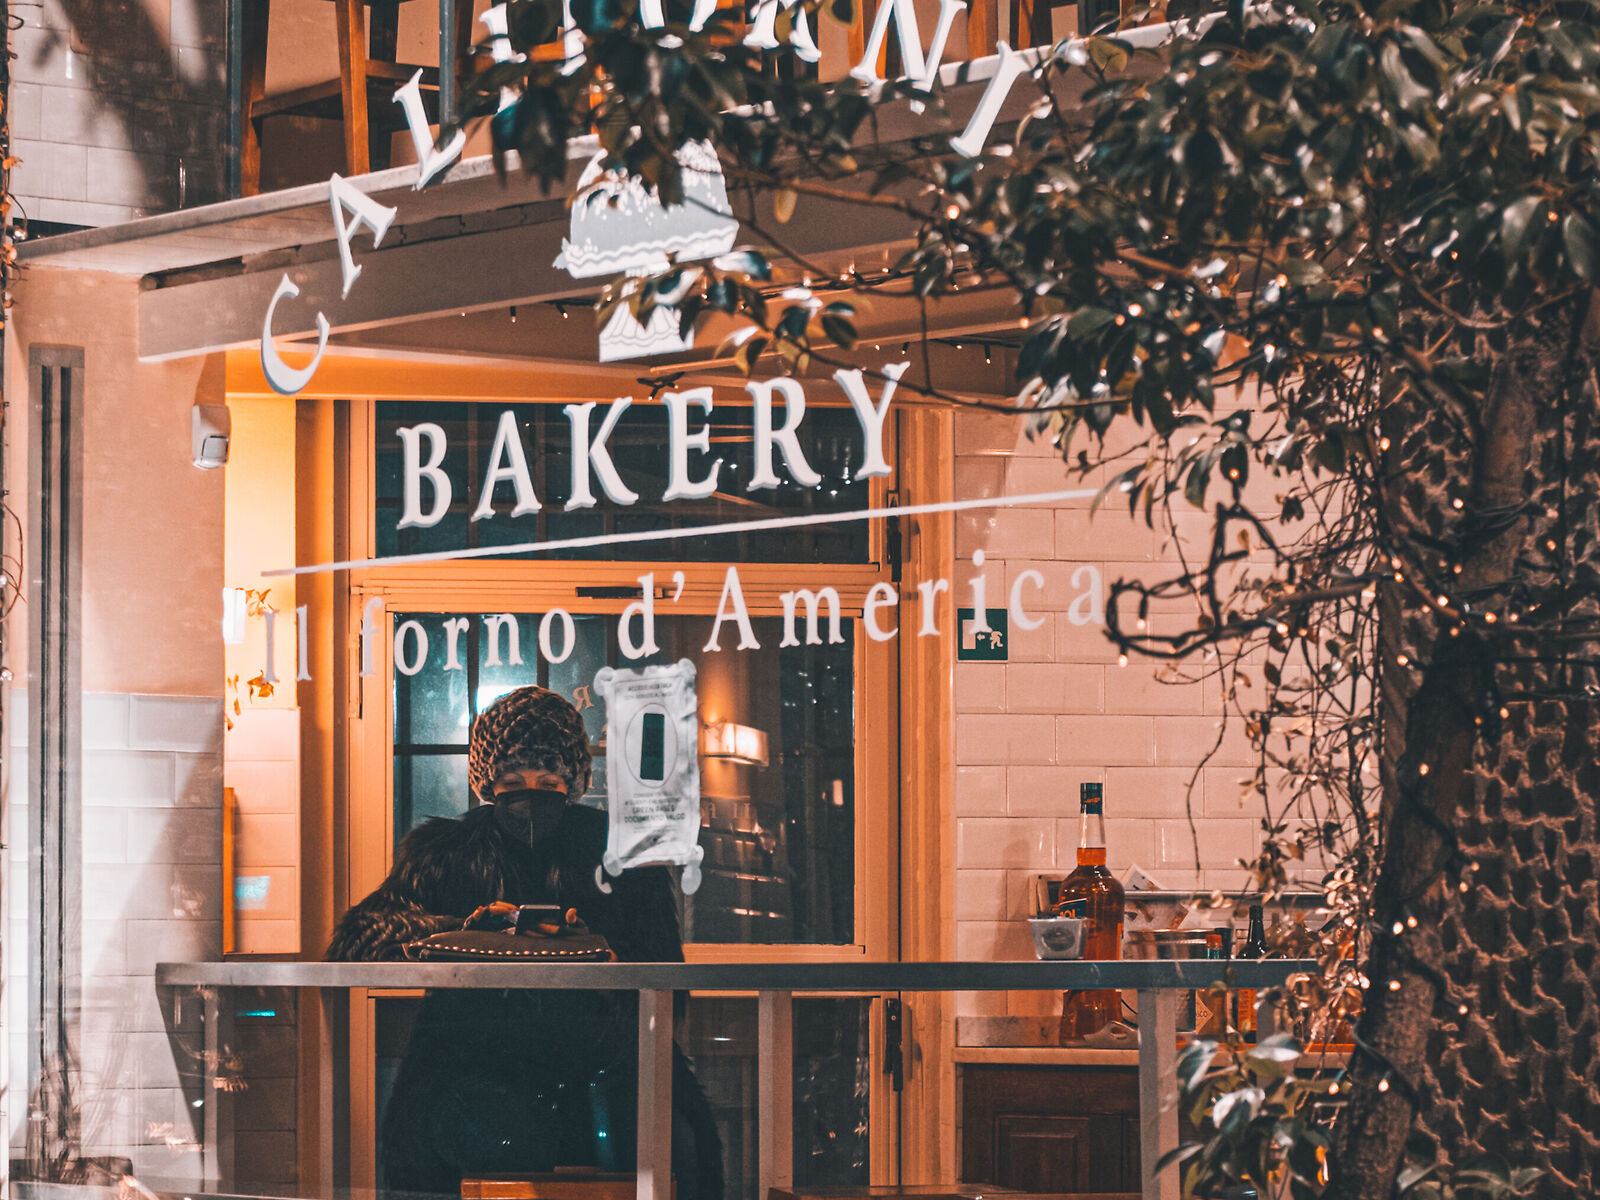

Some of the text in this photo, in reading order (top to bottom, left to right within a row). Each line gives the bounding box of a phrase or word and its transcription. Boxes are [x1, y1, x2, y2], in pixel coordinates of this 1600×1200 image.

[396, 361, 911, 530] BAKERY
[360, 597, 577, 677] forno
[618, 549, 1106, 660] d'America
